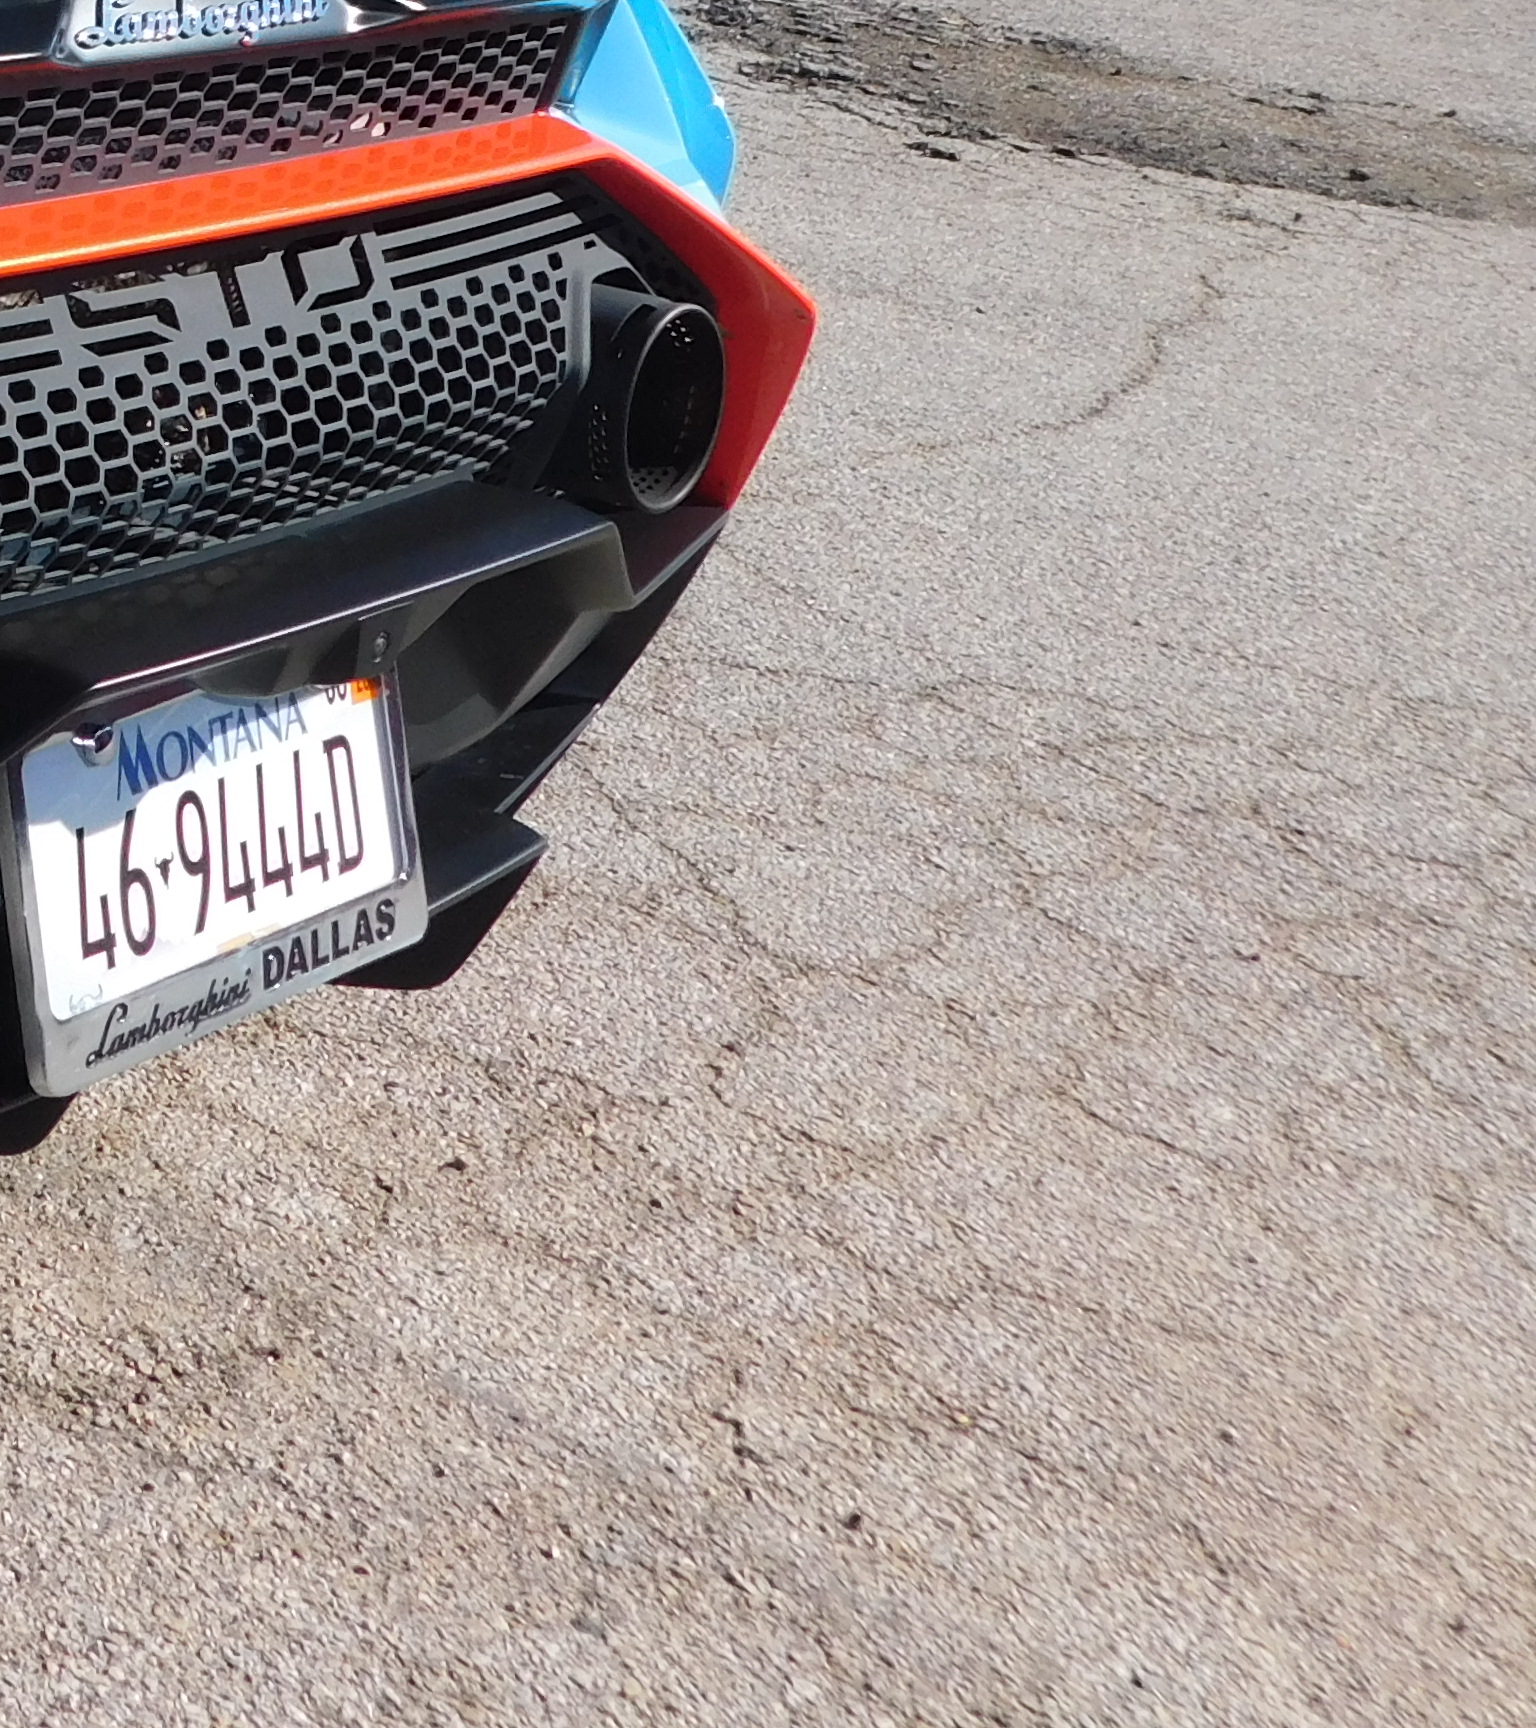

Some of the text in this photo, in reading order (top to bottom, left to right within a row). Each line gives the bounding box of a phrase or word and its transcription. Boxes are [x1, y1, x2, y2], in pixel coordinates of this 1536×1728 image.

[116, 692, 307, 801] MONTANA
[86, 898, 397, 1069] Lamborghini DALLAS
